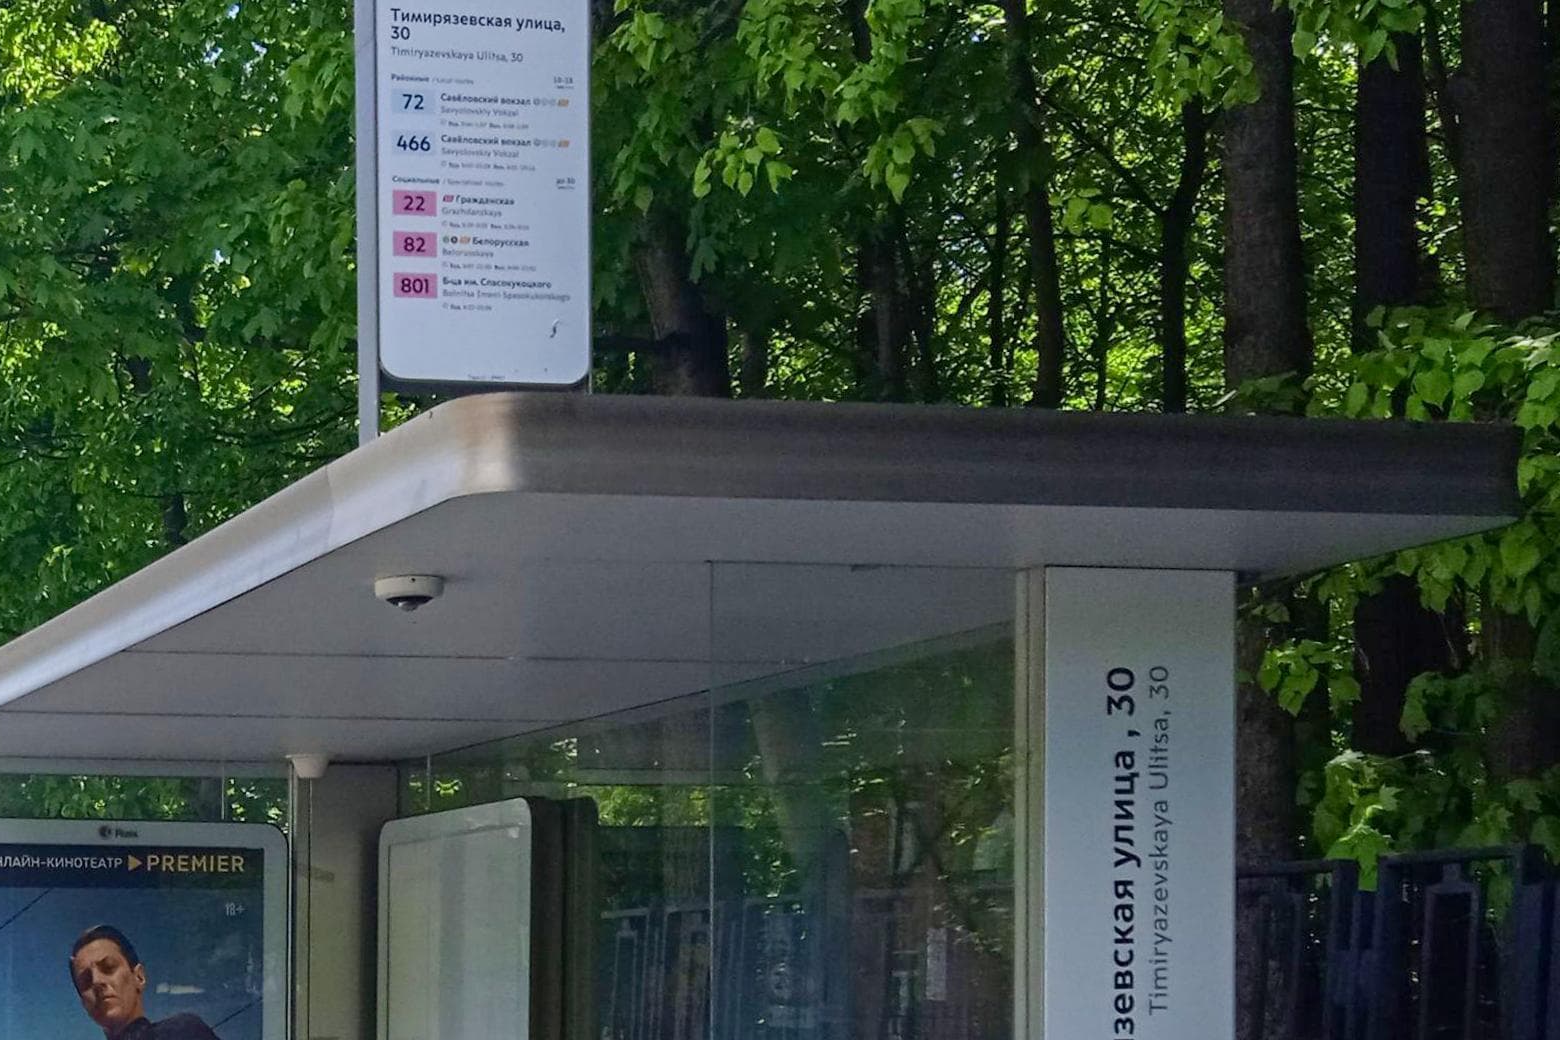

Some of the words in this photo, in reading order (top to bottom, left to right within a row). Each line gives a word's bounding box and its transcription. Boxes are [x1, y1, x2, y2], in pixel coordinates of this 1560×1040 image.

[390, 7, 513, 27] Тимирязевская
[516, 16, 566, 33] улица,
[390, 26, 411, 40] 30
[390, 46, 475, 60] Timiryazevskaya
[511, 53, 524, 63] 30
[402, 94, 425, 110] 72
[440, 93, 499, 105] Савёловский
[396, 135, 431, 151] 466
[440, 134, 499, 145] Савёловский
[403, 195, 426, 212] 22
[455, 194, 516, 206] Гражданская
[403, 236, 426, 253] 82
[472, 236, 530, 248] Белорусская
[400, 277, 430, 294] 801
[1148, 665, 1170, 700] 30
[1106, 666, 1136, 717] 30
[1148, 710, 1172, 791] Ulitsa,
[146, 854, 246, 873] PREMIER
[225, 902, 245, 916] 18+
[1148, 800, 1174, 1016] Timiryazevskaya
